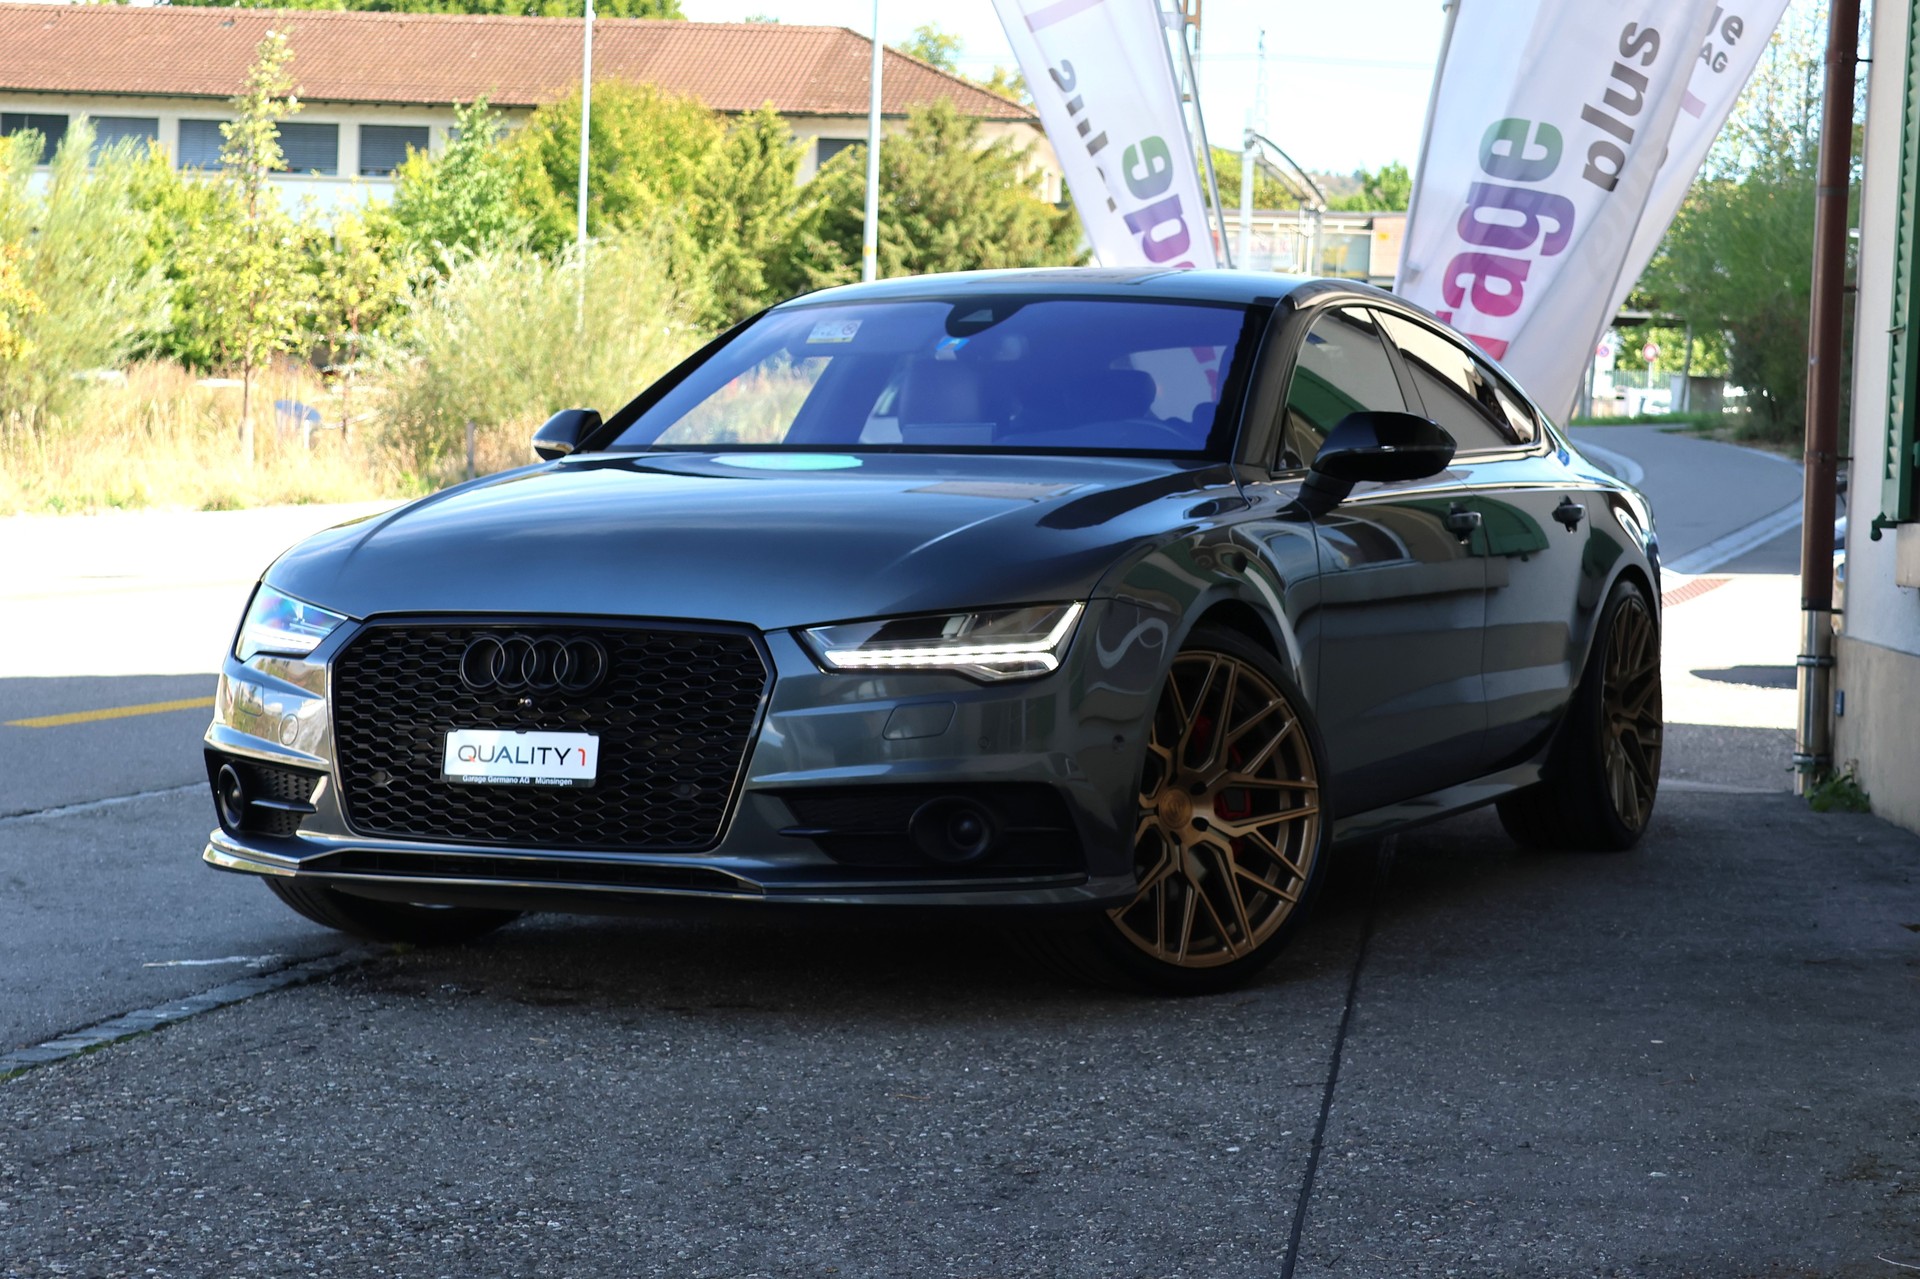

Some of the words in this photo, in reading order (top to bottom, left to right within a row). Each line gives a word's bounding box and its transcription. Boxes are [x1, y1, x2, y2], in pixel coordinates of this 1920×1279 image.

[1699, 41, 1728, 74] AG
[1580, 21, 1661, 192] plus
[458, 745, 571, 766] QUALITY
[578, 748, 586, 766] 1
[462, 775, 487, 784] Garage
[487, 775, 518, 784] Germano
[519, 776, 530, 784] AG
[535, 776, 573, 786] Münsingen
